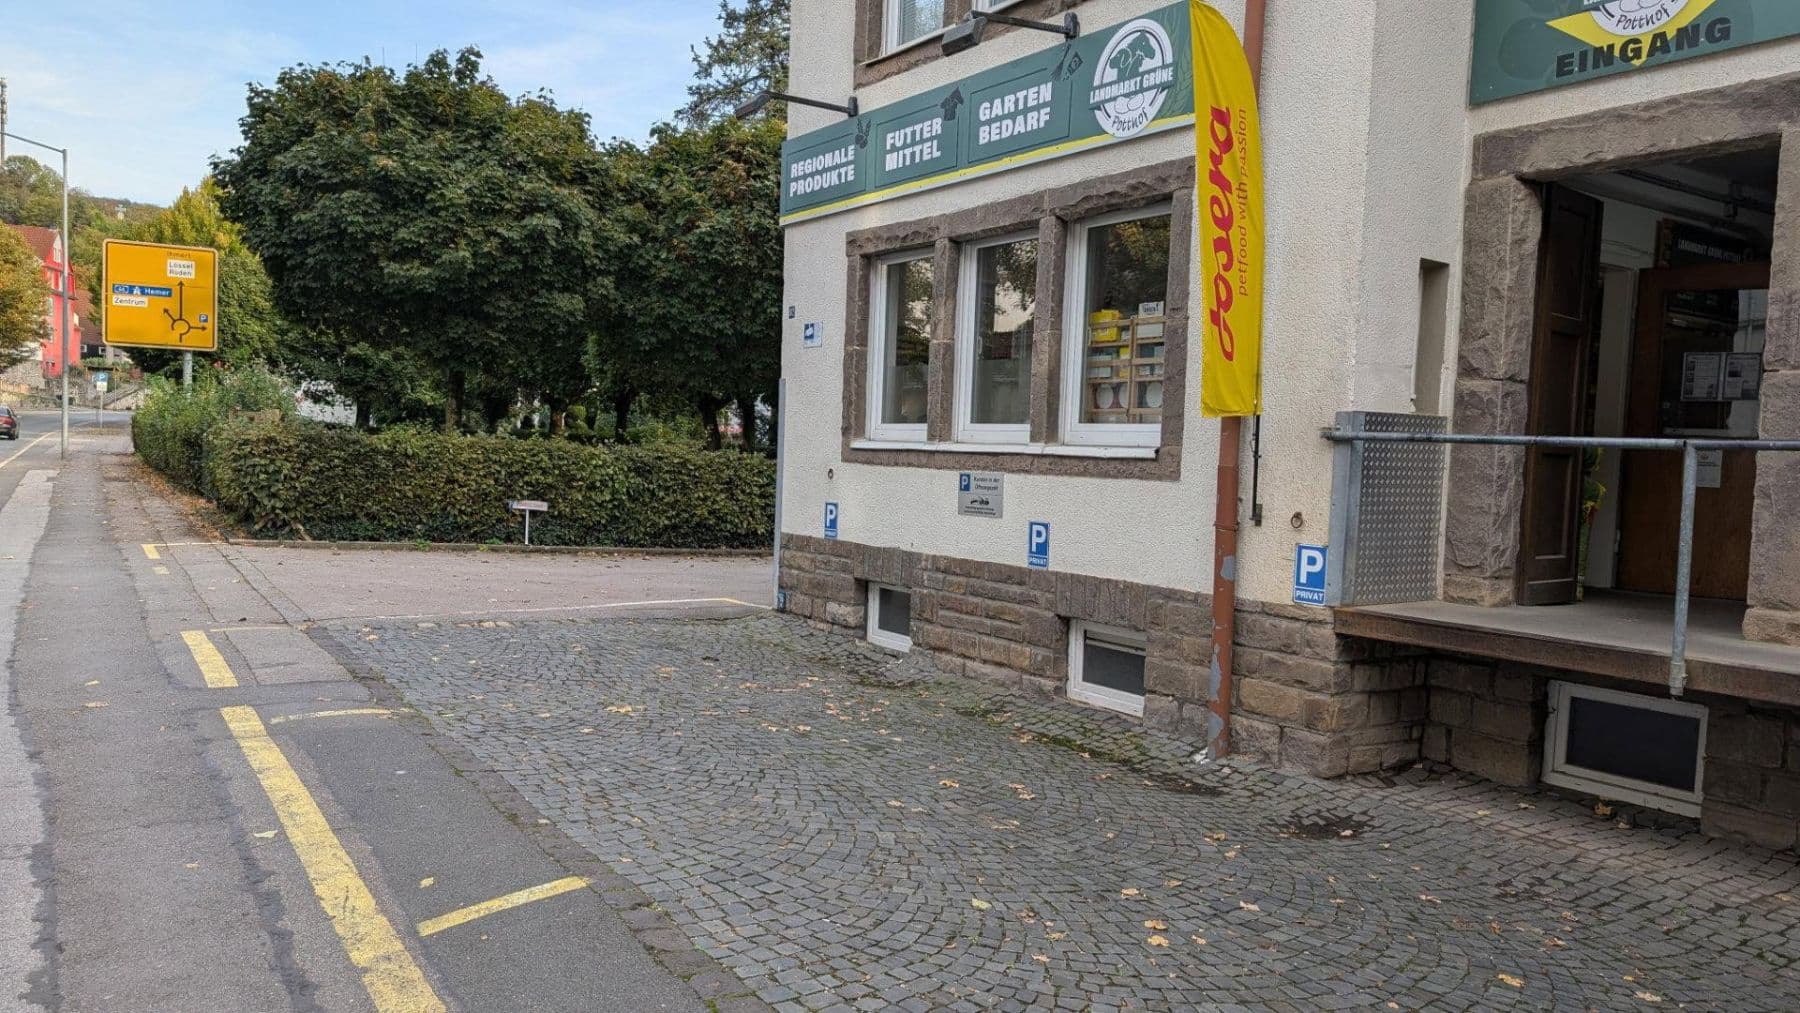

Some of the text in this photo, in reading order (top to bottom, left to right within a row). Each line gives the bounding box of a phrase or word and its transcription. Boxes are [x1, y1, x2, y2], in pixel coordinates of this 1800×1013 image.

[1616, 4, 1670, 30] Potthof
[1556, 17, 1731, 78] EINGANG
[979, 81, 1053, 121] GARTEN
[1090, 66, 1174, 104] LANDMARKT GRÜNE
[886, 117, 943, 150] FUTTER
[979, 107, 1051, 145] BEDARF
[790, 144, 855, 179] REGIONALE
[885, 139, 942, 172] MITTEL
[789, 164, 855, 197] PRODUKTE
[1235, 108, 1249, 297] petfood with passion
[114, 297, 146, 305] Zentrum
[962, 475, 969, 490] P
[826, 504, 837, 527] P
[1031, 524, 1047, 552] P
[1300, 549, 1324, 584] P
[1295, 590, 1324, 601] PRIVAT
